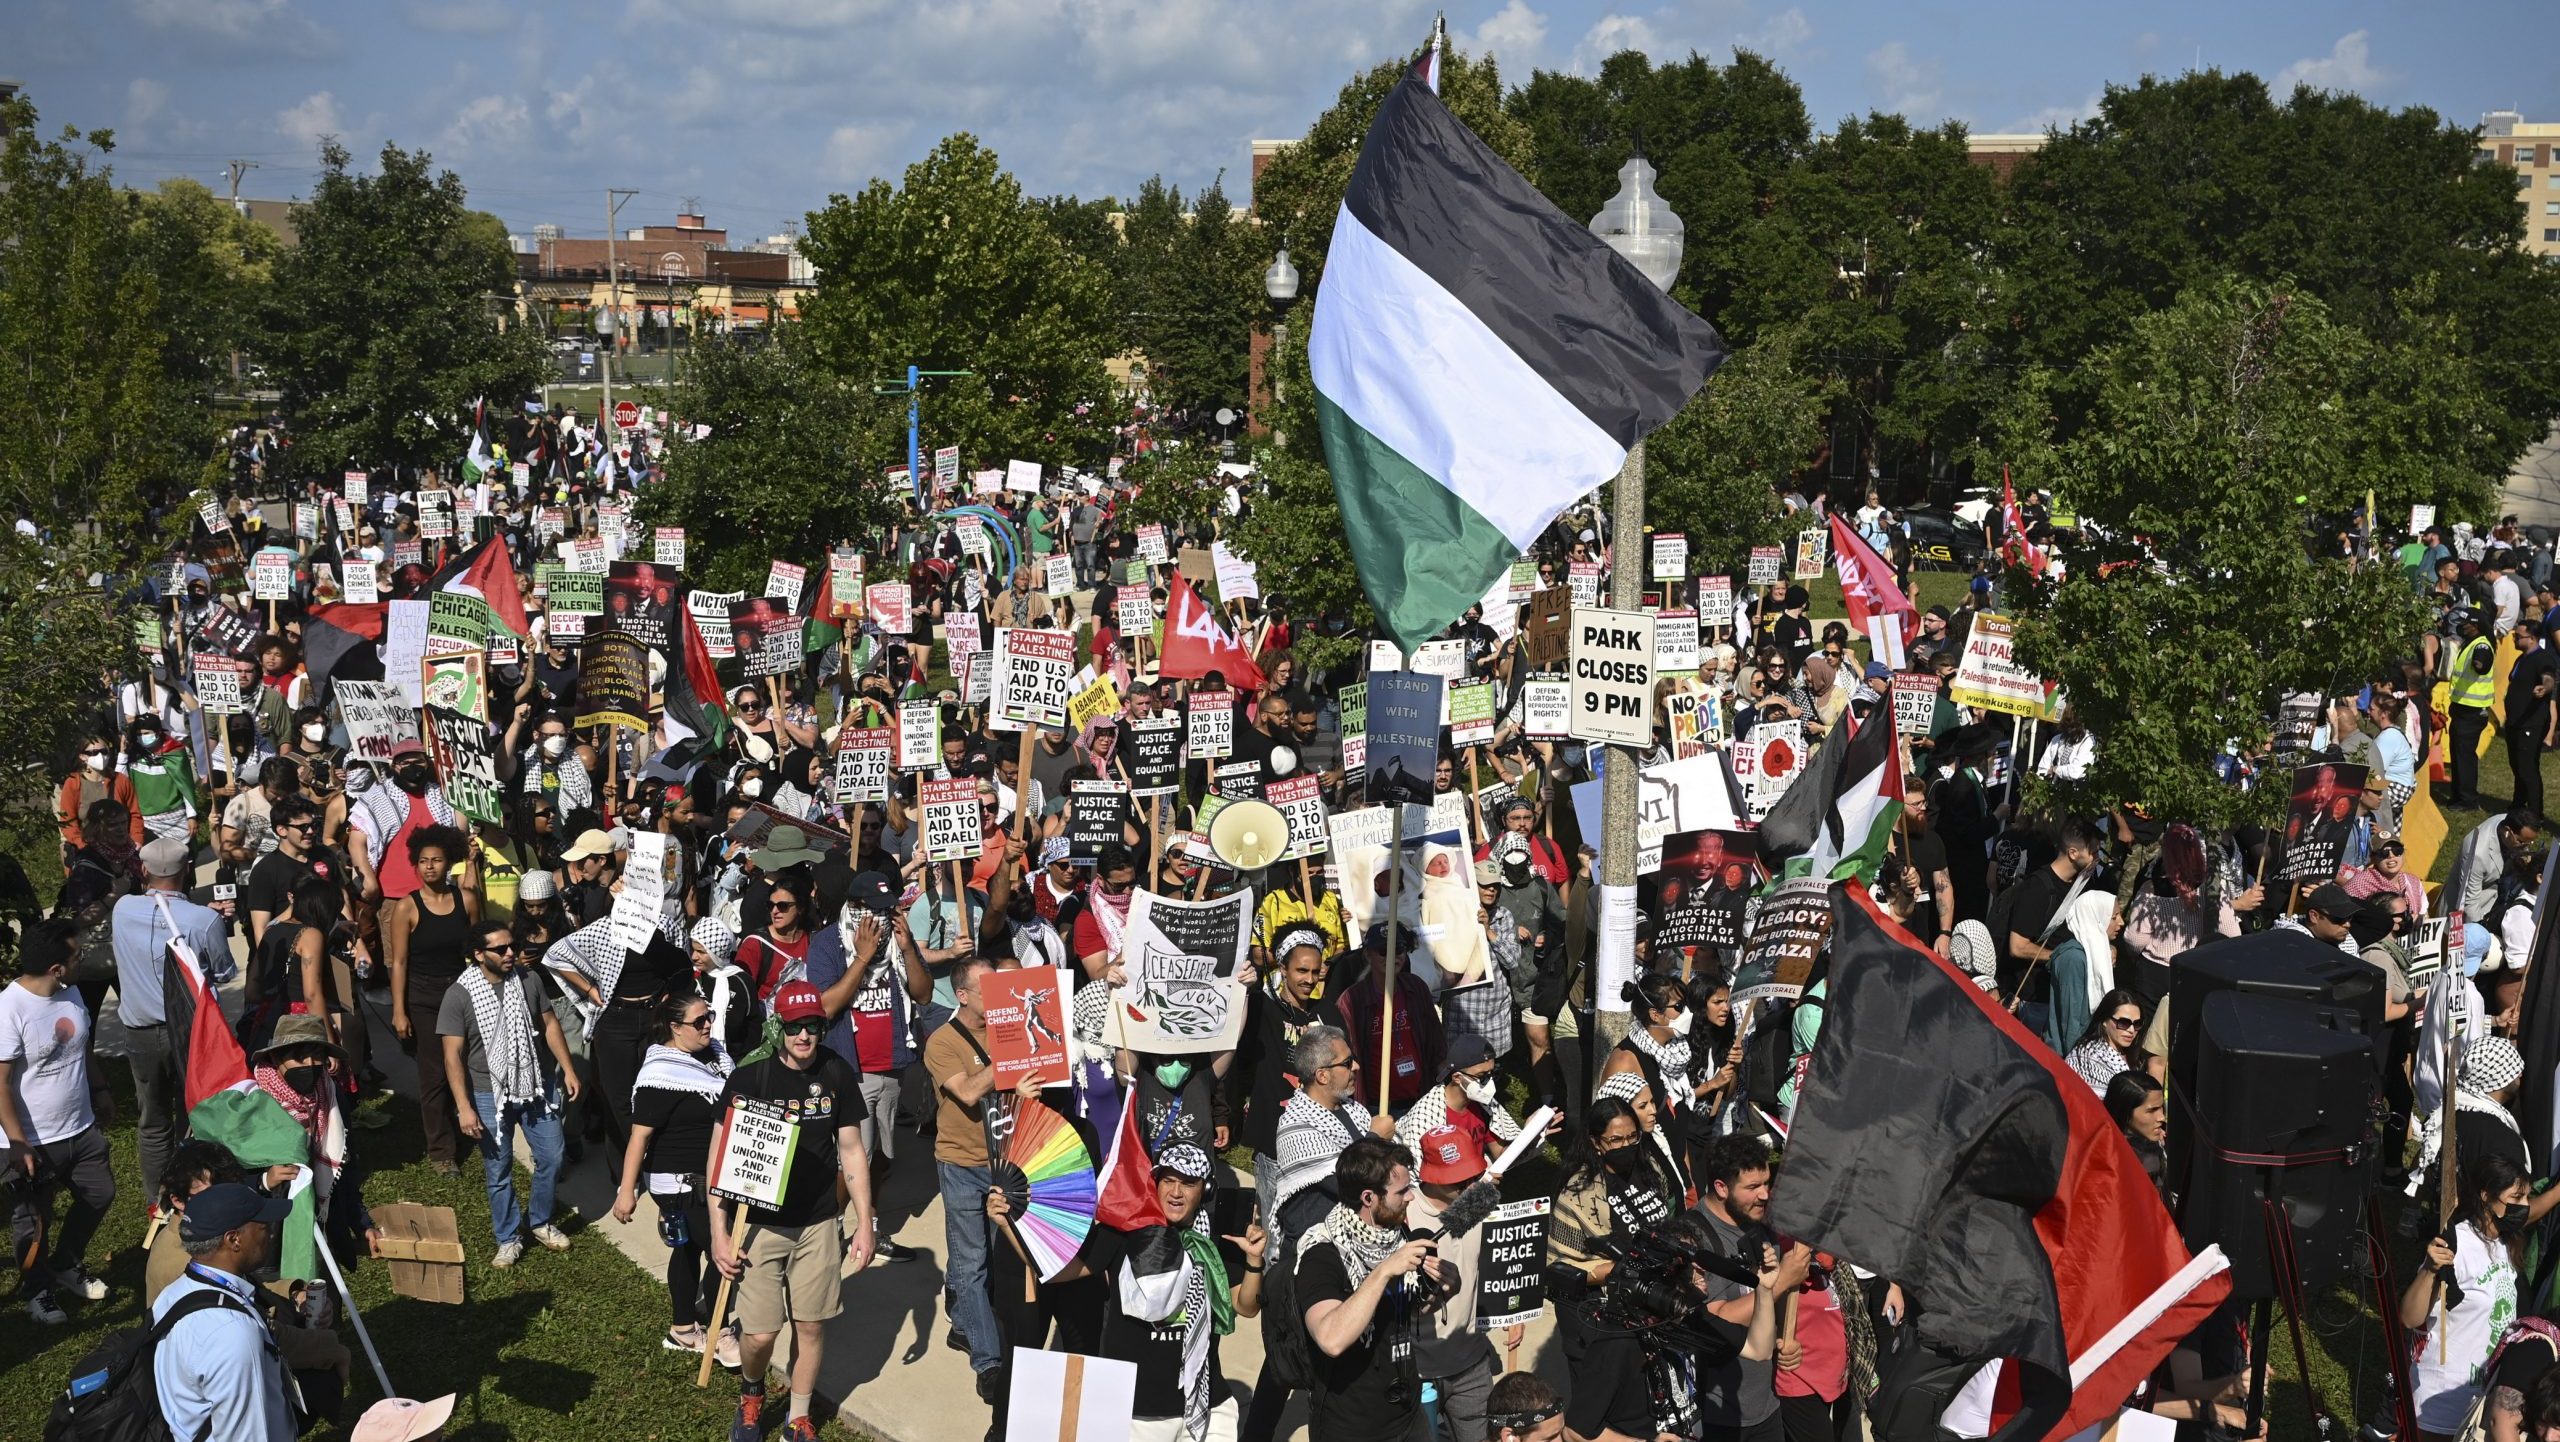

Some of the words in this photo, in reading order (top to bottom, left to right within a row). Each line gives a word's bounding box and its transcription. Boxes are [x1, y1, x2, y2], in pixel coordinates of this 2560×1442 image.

[616, 409, 637, 423] STOP
[1802, 533, 1814, 543] NO
[1814, 554, 1822, 562] IN
[1797, 561, 1822, 577] APARTHEID
[550, 581, 601, 594] CHICAGO
[550, 600, 602, 612] PALESTINE
[1538, 588, 1571, 610] FREE
[1986, 619, 2011, 632] Torah
[1012, 633, 1045, 646] STAND
[1049, 637, 1073, 648] WITH
[1584, 626, 1642, 651] PARK
[604, 644, 629, 653] BOTH
[1012, 643, 1072, 660] PALESTINE!
[1657, 645, 1675, 653] FOR
[1678, 645, 1696, 653] ALL!
[1969, 640, 1989, 657] ALL
[586, 655, 634, 666] DEMOCRATS
[1012, 658, 1039, 672] END
[587, 666, 643, 680] REPUBLICANS
[1577, 658, 1647, 685] CLOSES
[1983, 662, 1988, 670] be
[1989, 662, 2014, 674] returned
[2016, 667, 2022, 676] to
[198, 673, 217, 681] END
[581, 678, 602, 688] HAVE
[604, 677, 634, 689] BLOOD
[1010, 673, 1037, 688] AID
[1047, 676, 1066, 692] TO
[1960, 669, 1997, 687] Palestinian
[1999, 676, 2039, 694] Sovereignty
[199, 683, 218, 692] AID
[220, 683, 237, 692] TO
[586, 687, 610, 697] THEIR
[1387, 679, 1430, 693] STAND
[200, 692, 238, 703] ISRAEL!
[1009, 688, 1064, 708] ISRAEL!
[1074, 684, 1105, 715] ABANDON
[1190, 694, 1210, 702] STAND
[1213, 692, 1231, 700] WITH
[1190, 701, 1232, 709] PALESTINE!
[1584, 692, 1598, 712] 9
[1605, 694, 1641, 717] PM
[1966, 694, 2032, 715] www.nkusa.org
[385, 704, 416, 724] MURDER
[1386, 707, 1418, 718] WITH
[1534, 710, 1561, 718] RIGHTS!
[1369, 734, 1434, 748] PALESTINE
[2281, 739, 2309, 747] BUTCHER
[2286, 842, 2334, 858] DEMOCRATS
[2289, 854, 2306, 864] FUND
[2309, 851, 2325, 860] THE
[2280, 860, 2317, 875] GENOCIDE
[2321, 858, 2334, 867] OF
[2272, 867, 2334, 881] PALESTINIANS
[1153, 903, 1163, 911] WE
[1166, 908, 1186, 916] MUST
[1764, 898, 1800, 912] GENOCIDE
[1803, 897, 1830, 908] JOE'S
[1151, 912, 1170, 922] MAKE
[1665, 908, 1732, 920] DEMOCRATS
[1758, 909, 1827, 929] LEGACY:
[1669, 917, 1698, 927] FUND
[1702, 916, 1723, 925] THE
[1165, 925, 1200, 935] BOMBING
[1207, 924, 1236, 935] FAMILIES
[1659, 926, 1714, 937] GENOCIDE
[1718, 927, 1734, 935] OF
[1752, 933, 1768, 944] THE
[1769, 929, 1820, 942] BUTCHER
[1190, 936, 1234, 945] IMPOSSIBLE
[1655, 934, 1734, 946] PALESTINIANS
[1152, 956, 1214, 982] CEASEFIRE
[1180, 991, 1216, 1006] NOW
[986, 1007, 1018, 1018] DEFEND
[987, 1014, 1024, 1025] CHICAGO
[748, 1100, 768, 1109] STAND
[769, 1105, 784, 1114] WITH
[748, 1106, 781, 1119] PALESTINE!
[742, 1116, 782, 1133] DEFEND
[735, 1124, 755, 1136] THE
[757, 1129, 787, 1145] RIGHT
[752, 1139, 765, 1150] TO
[733, 1145, 779, 1166] UNIONIZE
[742, 1159, 764, 1171] AND
[734, 1168, 772, 1185] STRIKE!
[1506, 1264, 1522, 1275] AND
[1484, 1274, 1539, 1293] EQUALITY!
